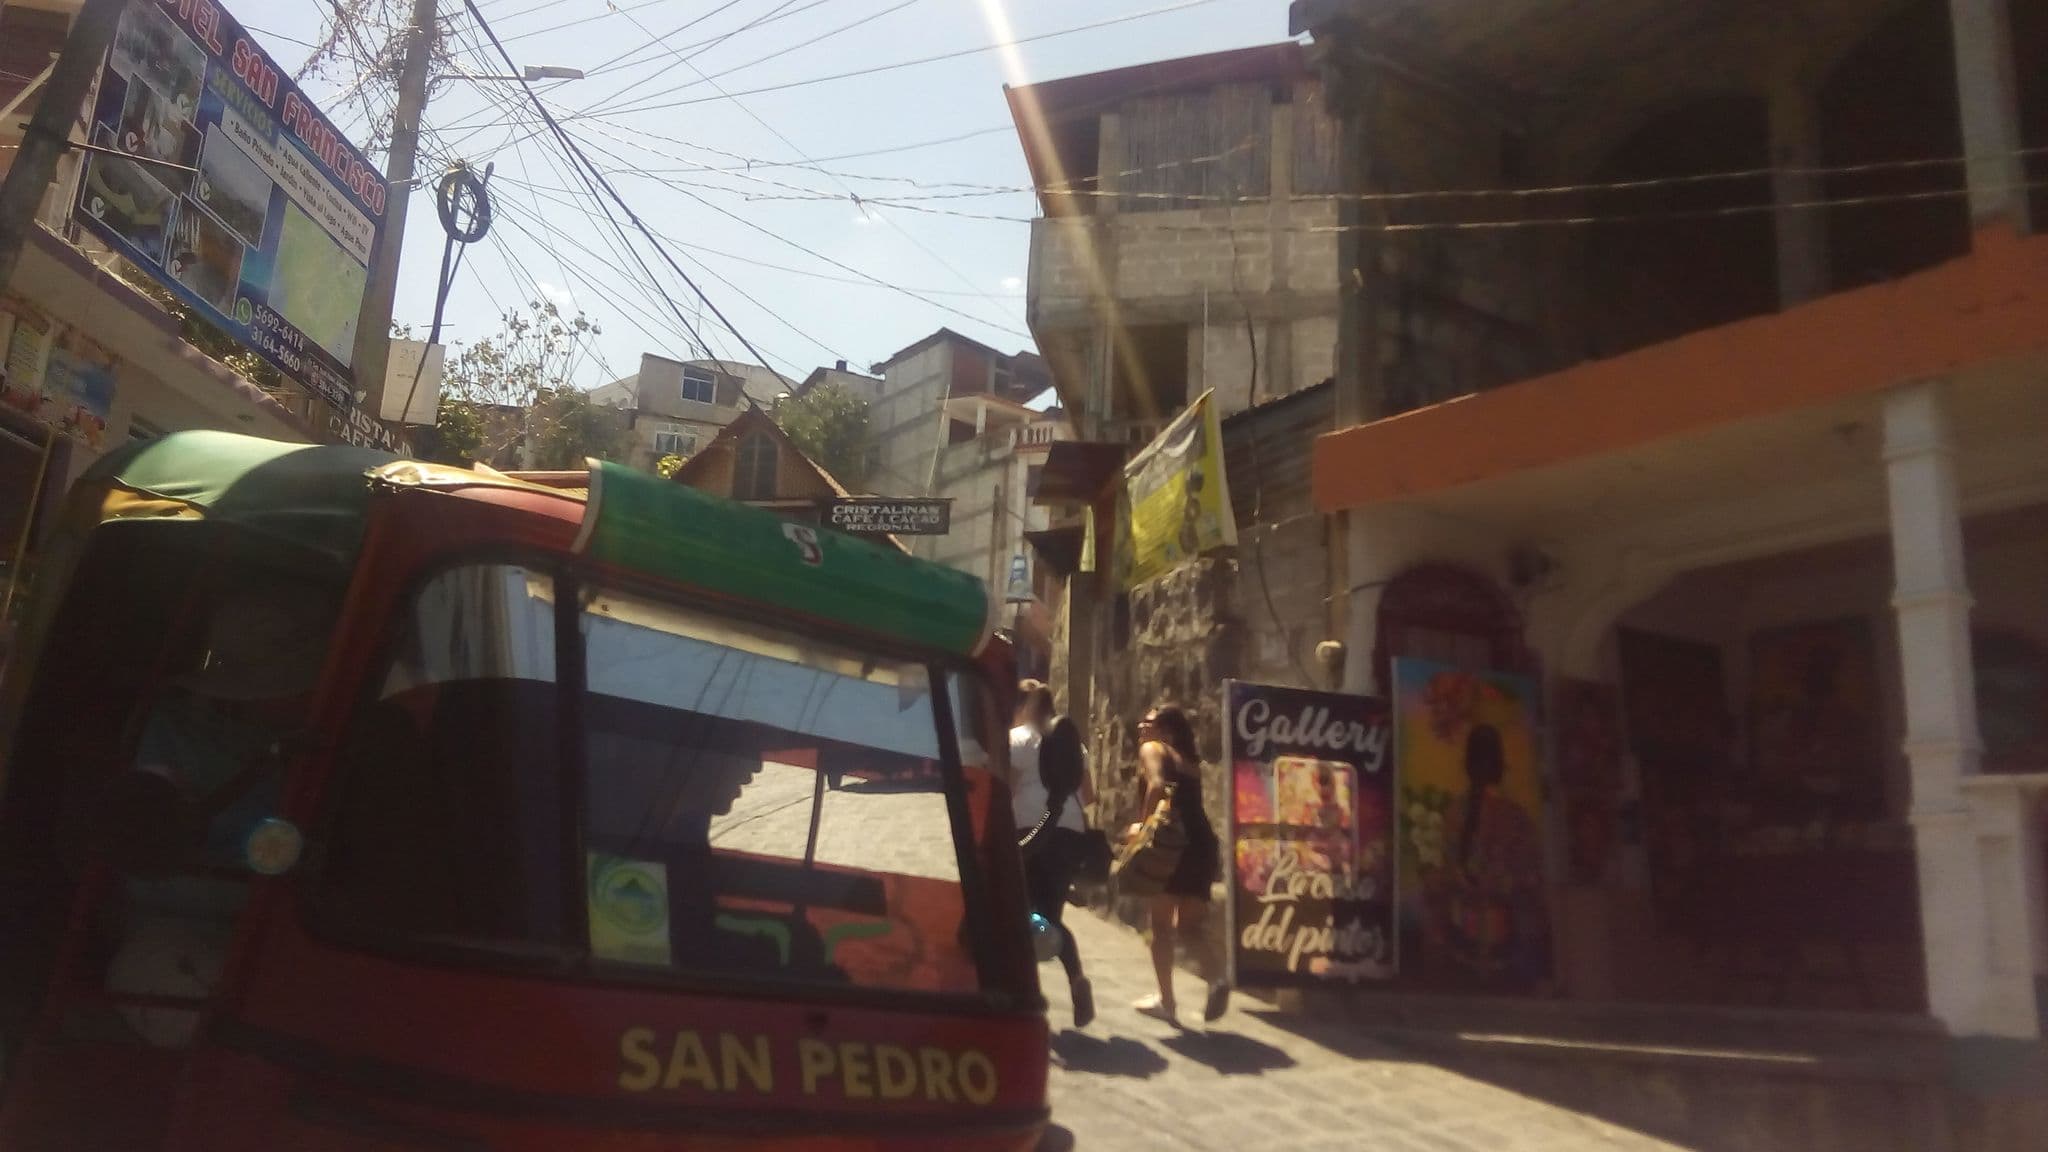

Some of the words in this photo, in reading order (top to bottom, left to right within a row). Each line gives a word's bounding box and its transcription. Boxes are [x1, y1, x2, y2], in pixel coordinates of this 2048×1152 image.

[232, 38, 279, 109] SAN
[282, 91, 386, 216] FRANCISCO
[234, 121, 251, 145] Baño
[252, 139, 274, 166] Privado
[251, 326, 301, 372] 3164-5660
[254, 304, 304, 352] 5692-6414
[1236, 698, 1387, 772] Gallery
[619, 1026, 773, 1093] SAN
[799, 1037, 998, 1105] PEDRO
